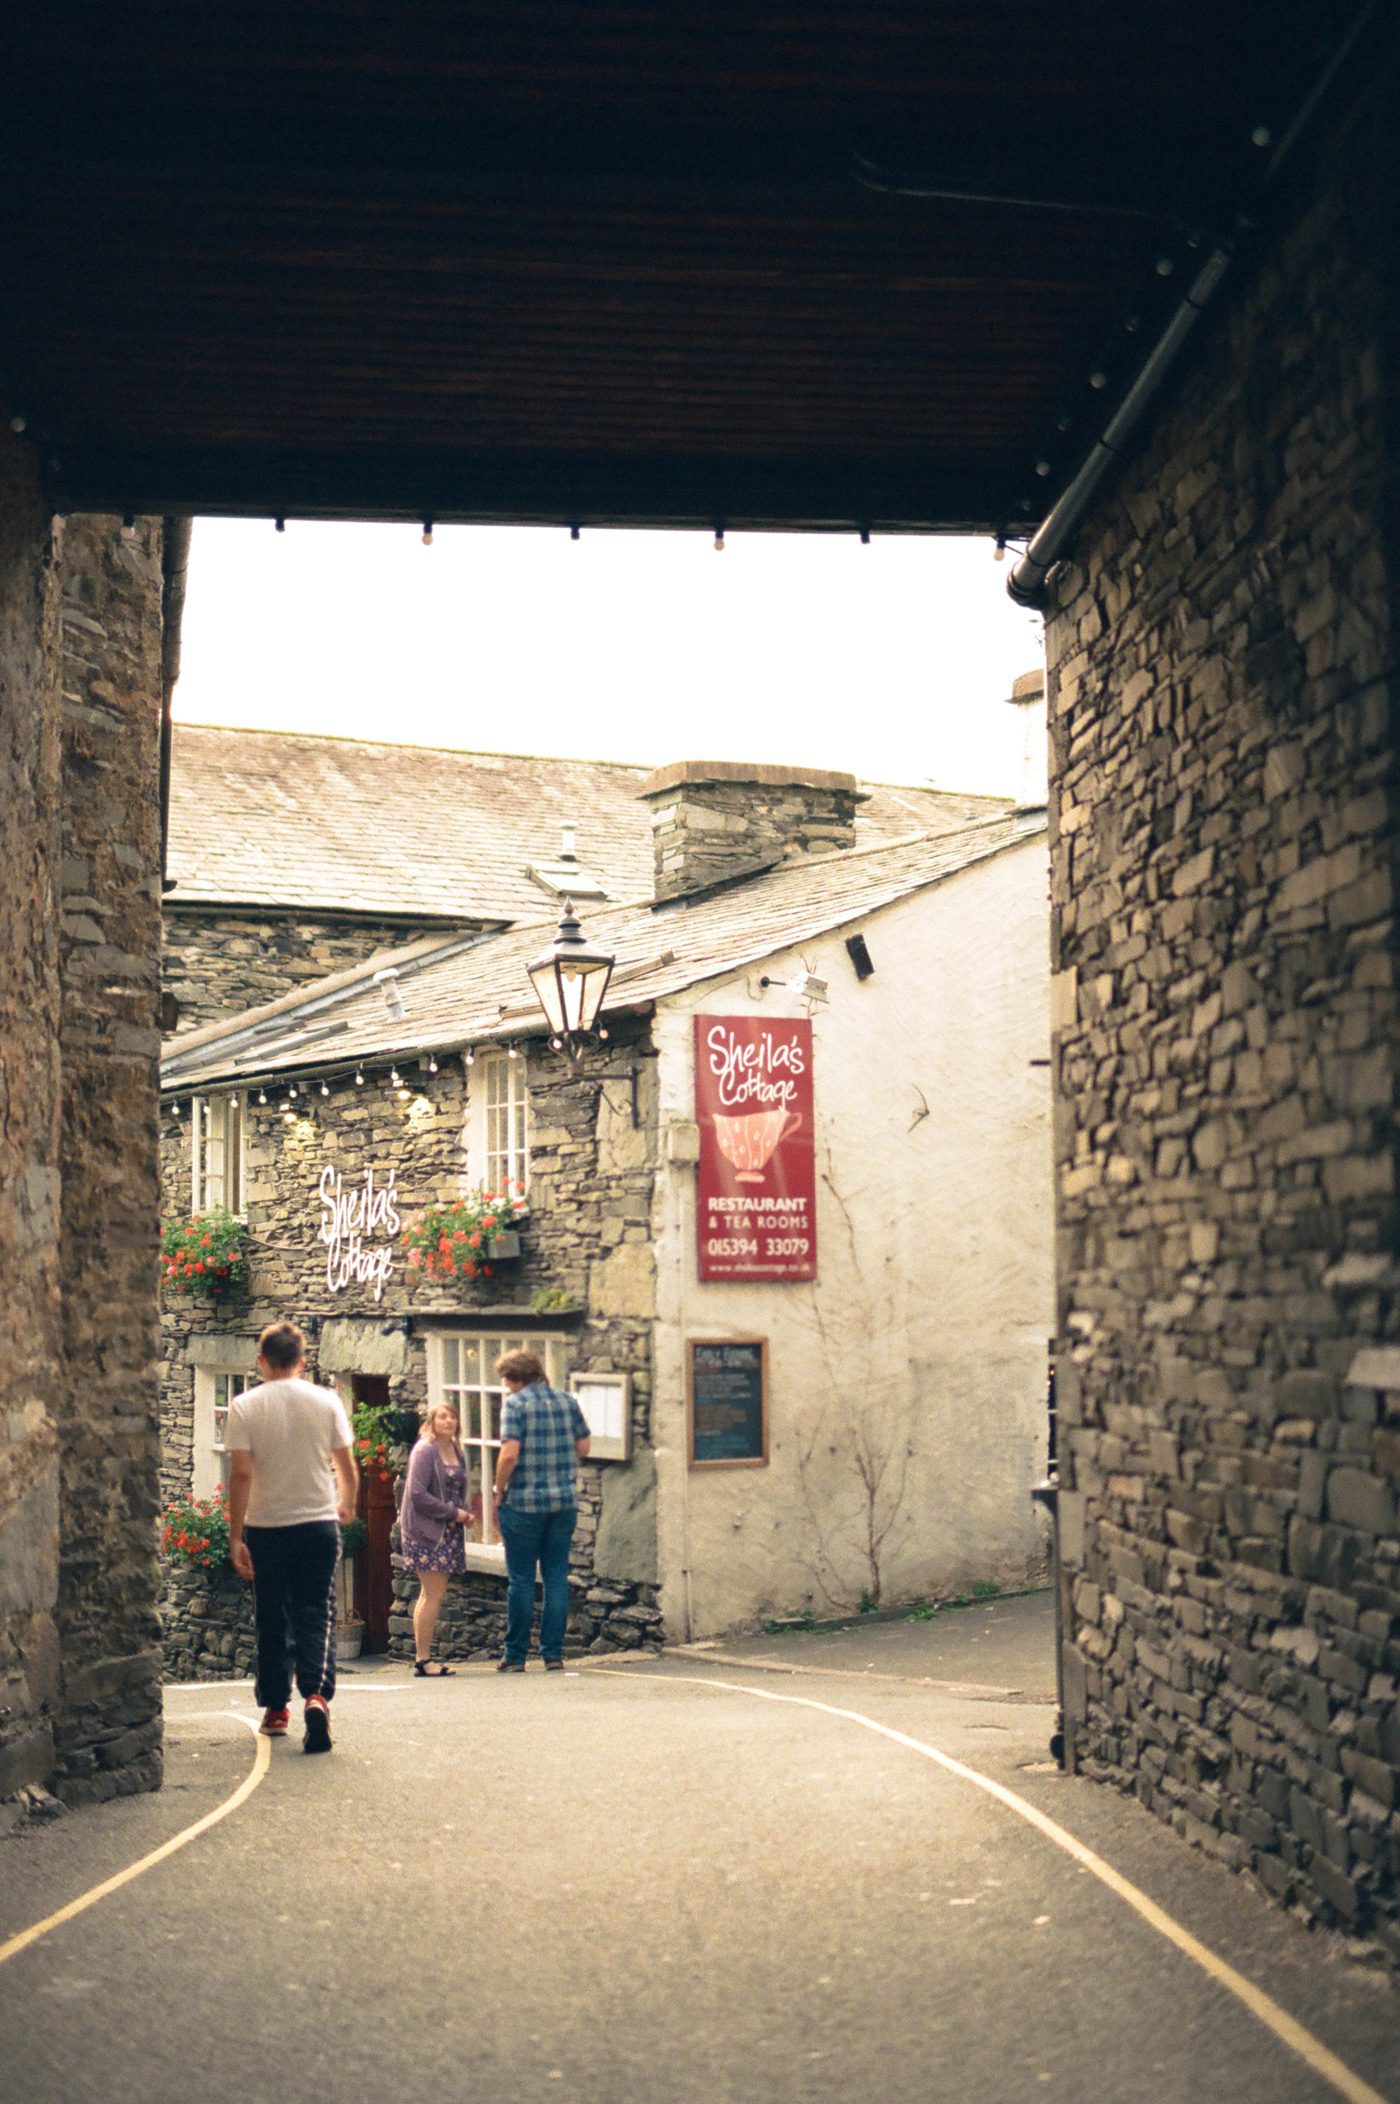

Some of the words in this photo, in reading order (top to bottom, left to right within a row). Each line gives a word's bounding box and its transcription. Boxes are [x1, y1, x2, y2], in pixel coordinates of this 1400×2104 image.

[707, 1025, 805, 1091] Sheila's
[719, 1068, 798, 1113] Cottage
[320, 1165, 400, 1267] Sheila's
[708, 1197, 807, 1211] RESTAURANT
[708, 1216, 718, 1229] &
[723, 1215, 751, 1229] TEA
[757, 1215, 809, 1229] ROOMS
[327, 1232, 393, 1302] Cottage
[708, 1238, 757, 1256] 015394
[766, 1238, 810, 1256] 33079
